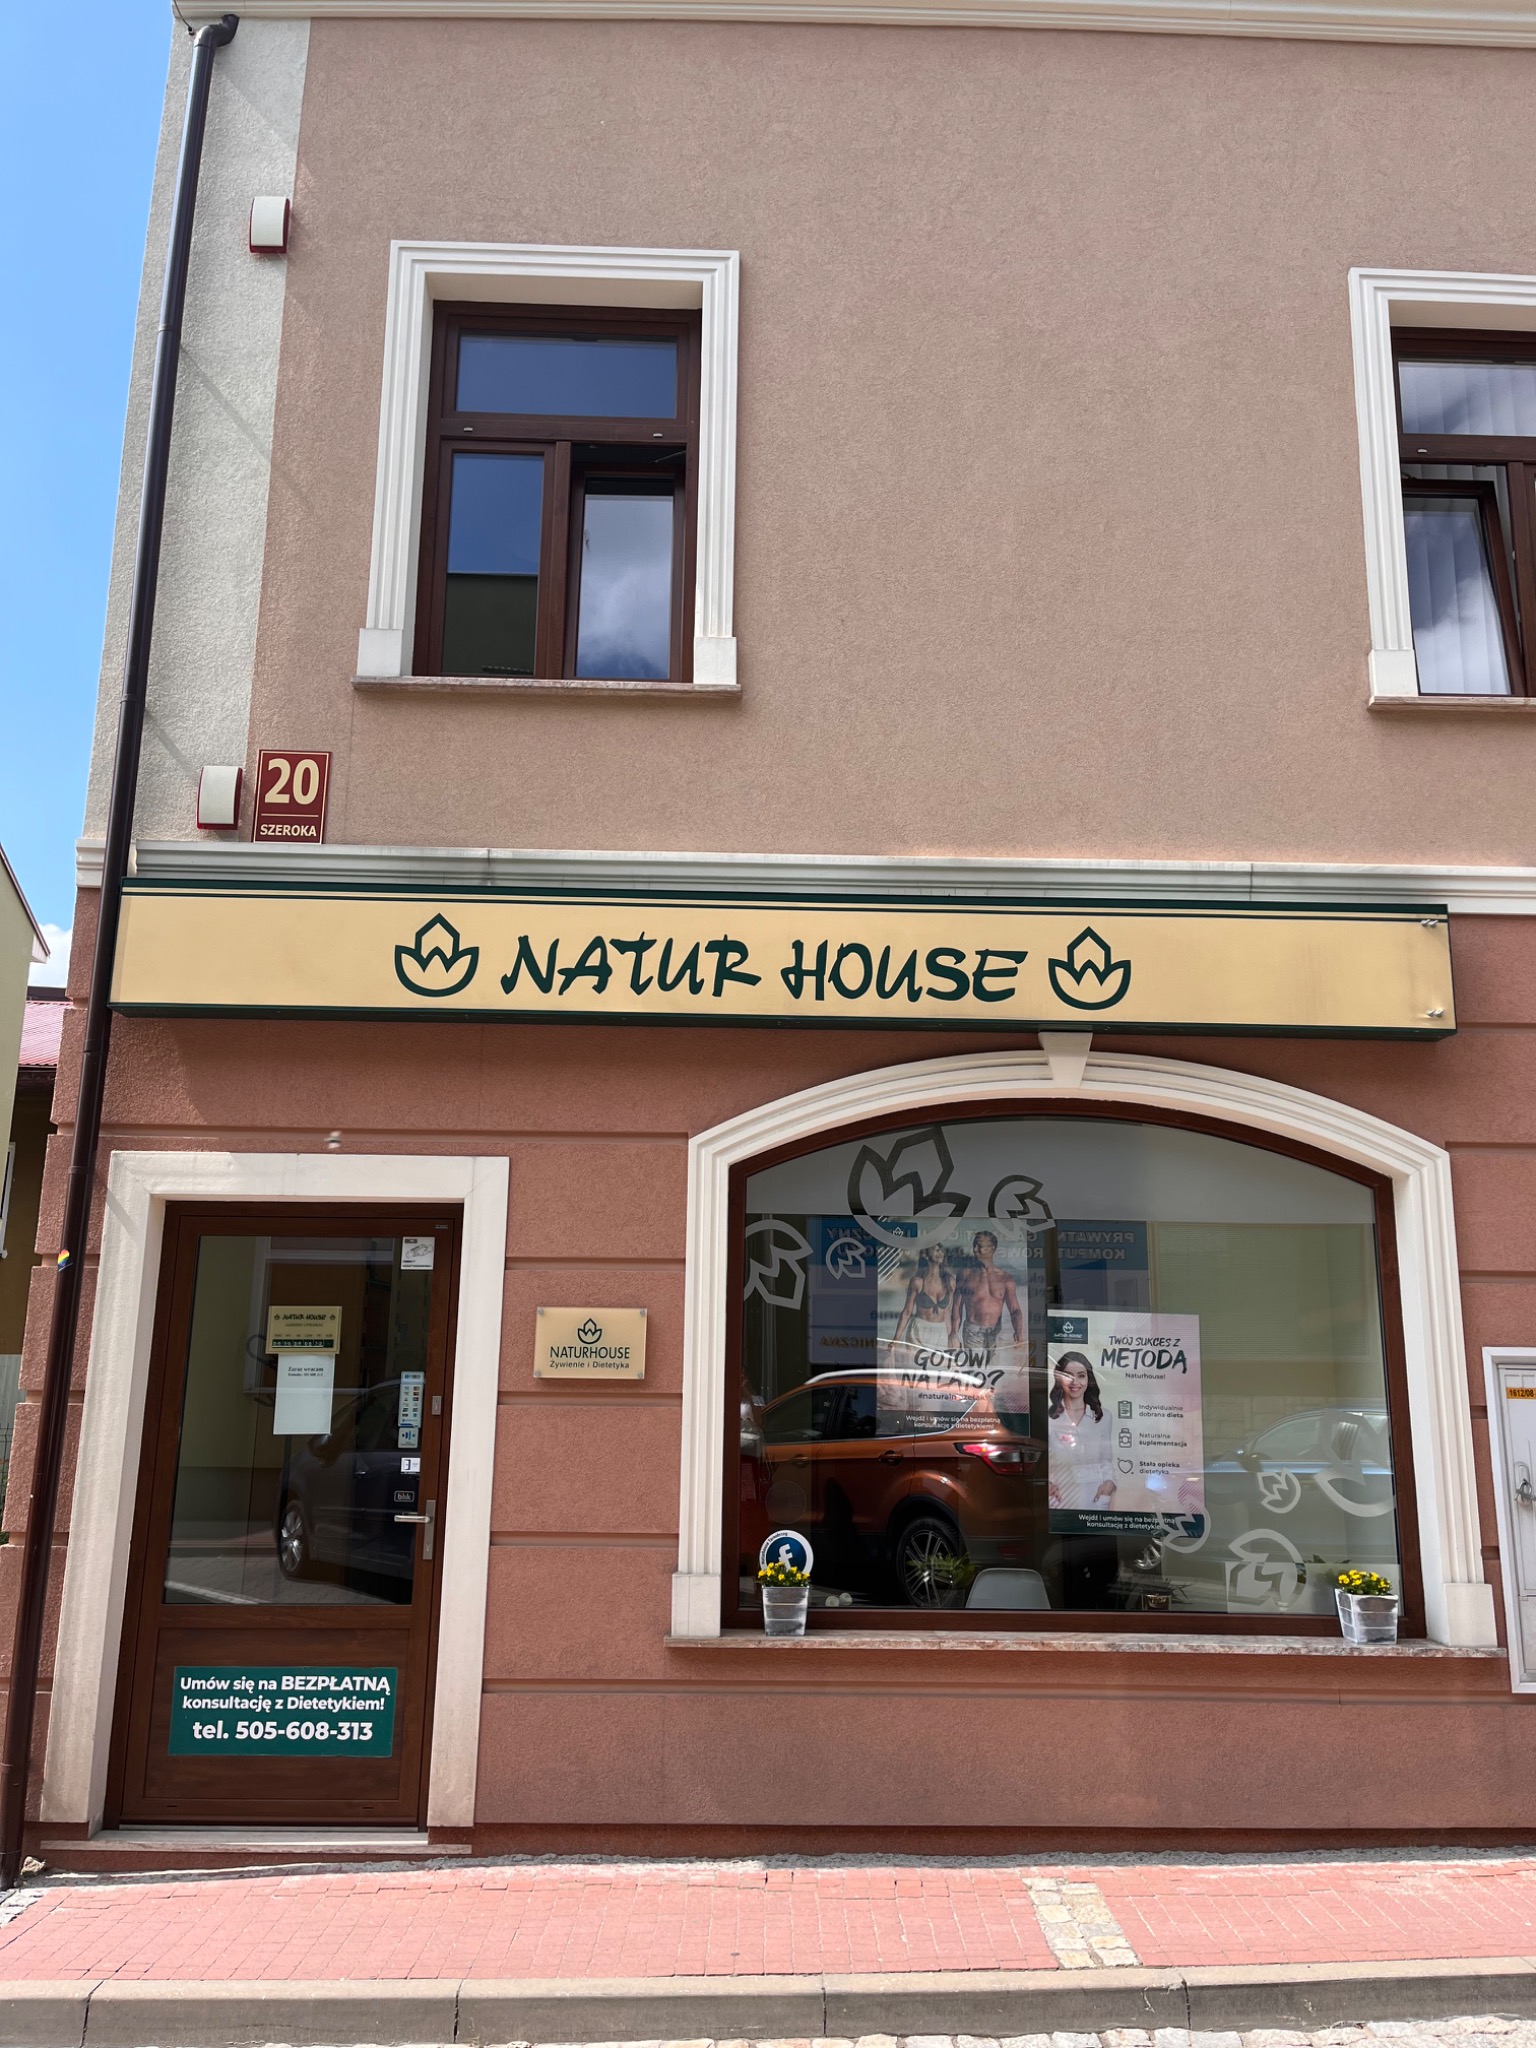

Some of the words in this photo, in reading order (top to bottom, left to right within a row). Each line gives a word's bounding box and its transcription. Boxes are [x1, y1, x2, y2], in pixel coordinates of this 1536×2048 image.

[264, 758, 320, 805] 20
[259, 824, 317, 837] SZEROKA
[500, 931, 762, 999] NATUR
[780, 938, 1028, 1003] HOUSE
[1109, 1334, 1133, 1346] TWÓJ
[1135, 1337, 1172, 1347] SUKCES
[1173, 1338, 1181, 1347] Z
[549, 1346, 630, 1359] NATURHOUSE
[914, 1347, 992, 1370] GOTOWI
[592, 1361, 630, 1370] Dietetyka
[1101, 1347, 1187, 1374] METODĄ
[936, 1369, 1005, 1393] LATO?
[1125, 1372, 1166, 1380] Naturhouse!
[1138, 1404, 1184, 1412] Indywidualnie
[1138, 1410, 1166, 1418] dobrana
[1139, 1432, 1171, 1440] Naturalna
[1139, 1439, 1188, 1449] suplementacja
[1139, 1468, 1170, 1476] dietetyka
[1157, 1462, 1180, 1470] opieka
[1078, 1514, 1098, 1522] Wejdź
[1144, 1517, 1175, 1525] bezptną
[1086, 1521, 1124, 1529] konsultację
[180, 1676, 230, 1690] Umów
[233, 1677, 254, 1693] się
[258, 1678, 277, 1690] na
[281, 1676, 391, 1696] BEZPŁATNĄ
[182, 1696, 272, 1713] konsultację
[274, 1698, 284, 1710] z
[287, 1696, 385, 1713] Dietetykiem!
[192, 1720, 229, 1739] tel.
[235, 1721, 373, 1740] 505-608-313
